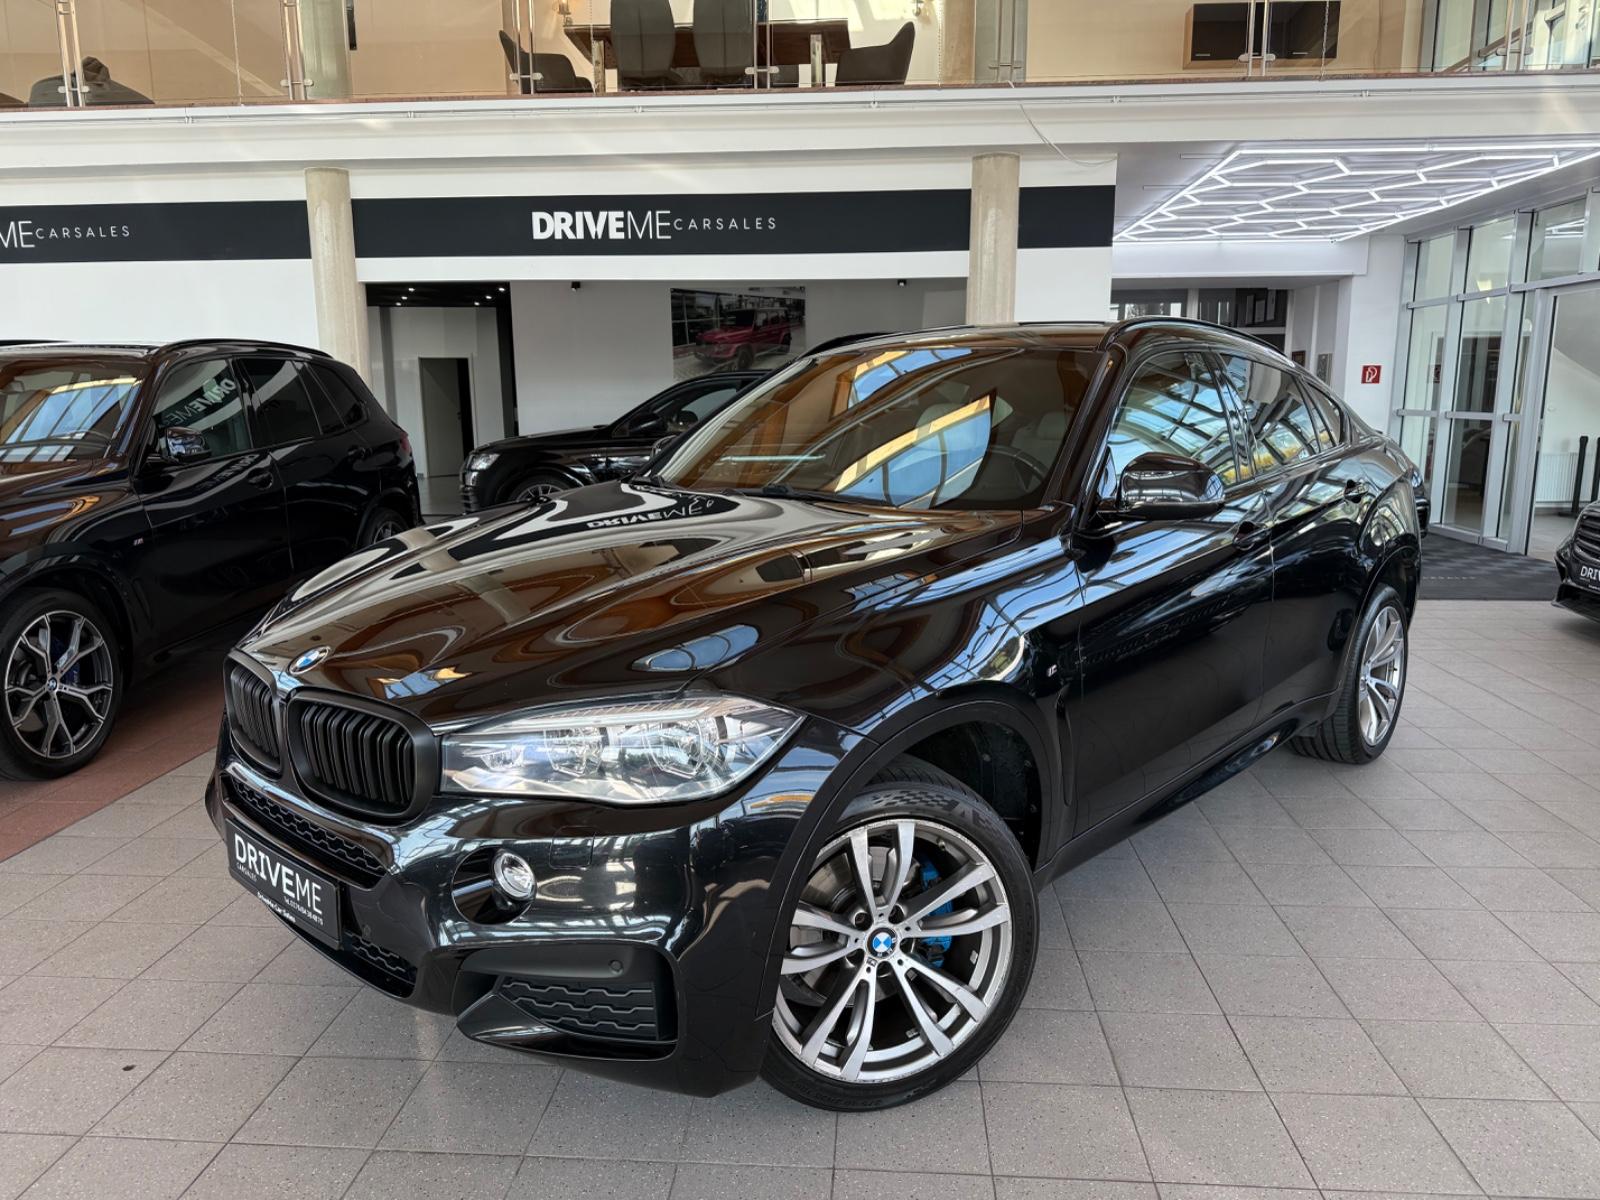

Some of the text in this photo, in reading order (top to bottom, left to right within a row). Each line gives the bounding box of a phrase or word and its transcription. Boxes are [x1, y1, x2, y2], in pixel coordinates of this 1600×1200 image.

[673, 217, 777, 231] CARSALES
[35, 225, 130, 240] CARSALES
[1580, 565, 1600, 581] DRI
[234, 833, 323, 915] DRIVEME
